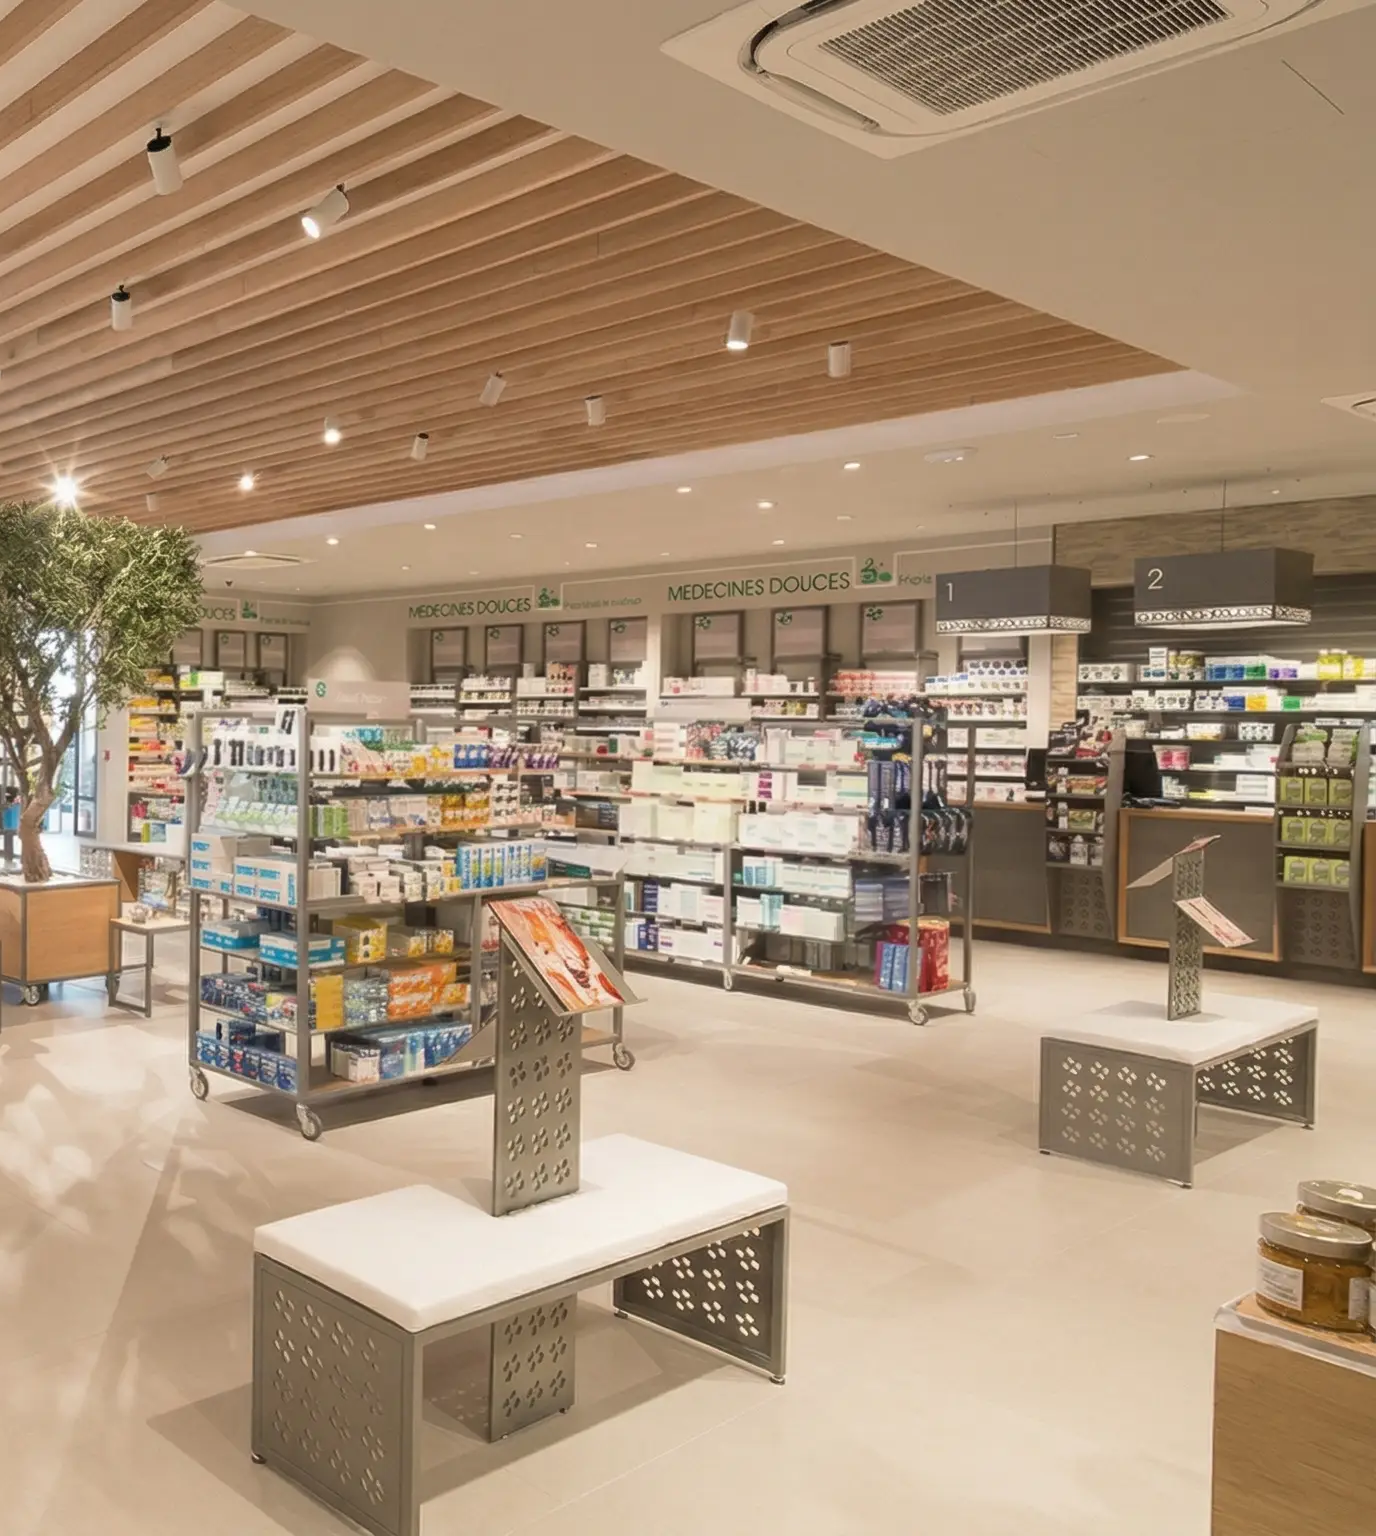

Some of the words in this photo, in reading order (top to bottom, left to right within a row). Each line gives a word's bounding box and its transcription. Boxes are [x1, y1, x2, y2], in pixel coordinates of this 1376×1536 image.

[668, 578, 765, 602] MEDECINES
[769, 571, 851, 594] DOUCES
[1147, 568, 1164, 590] 2
[945, 582, 954, 602] 1
[477, 597, 532, 615] DOUCES
